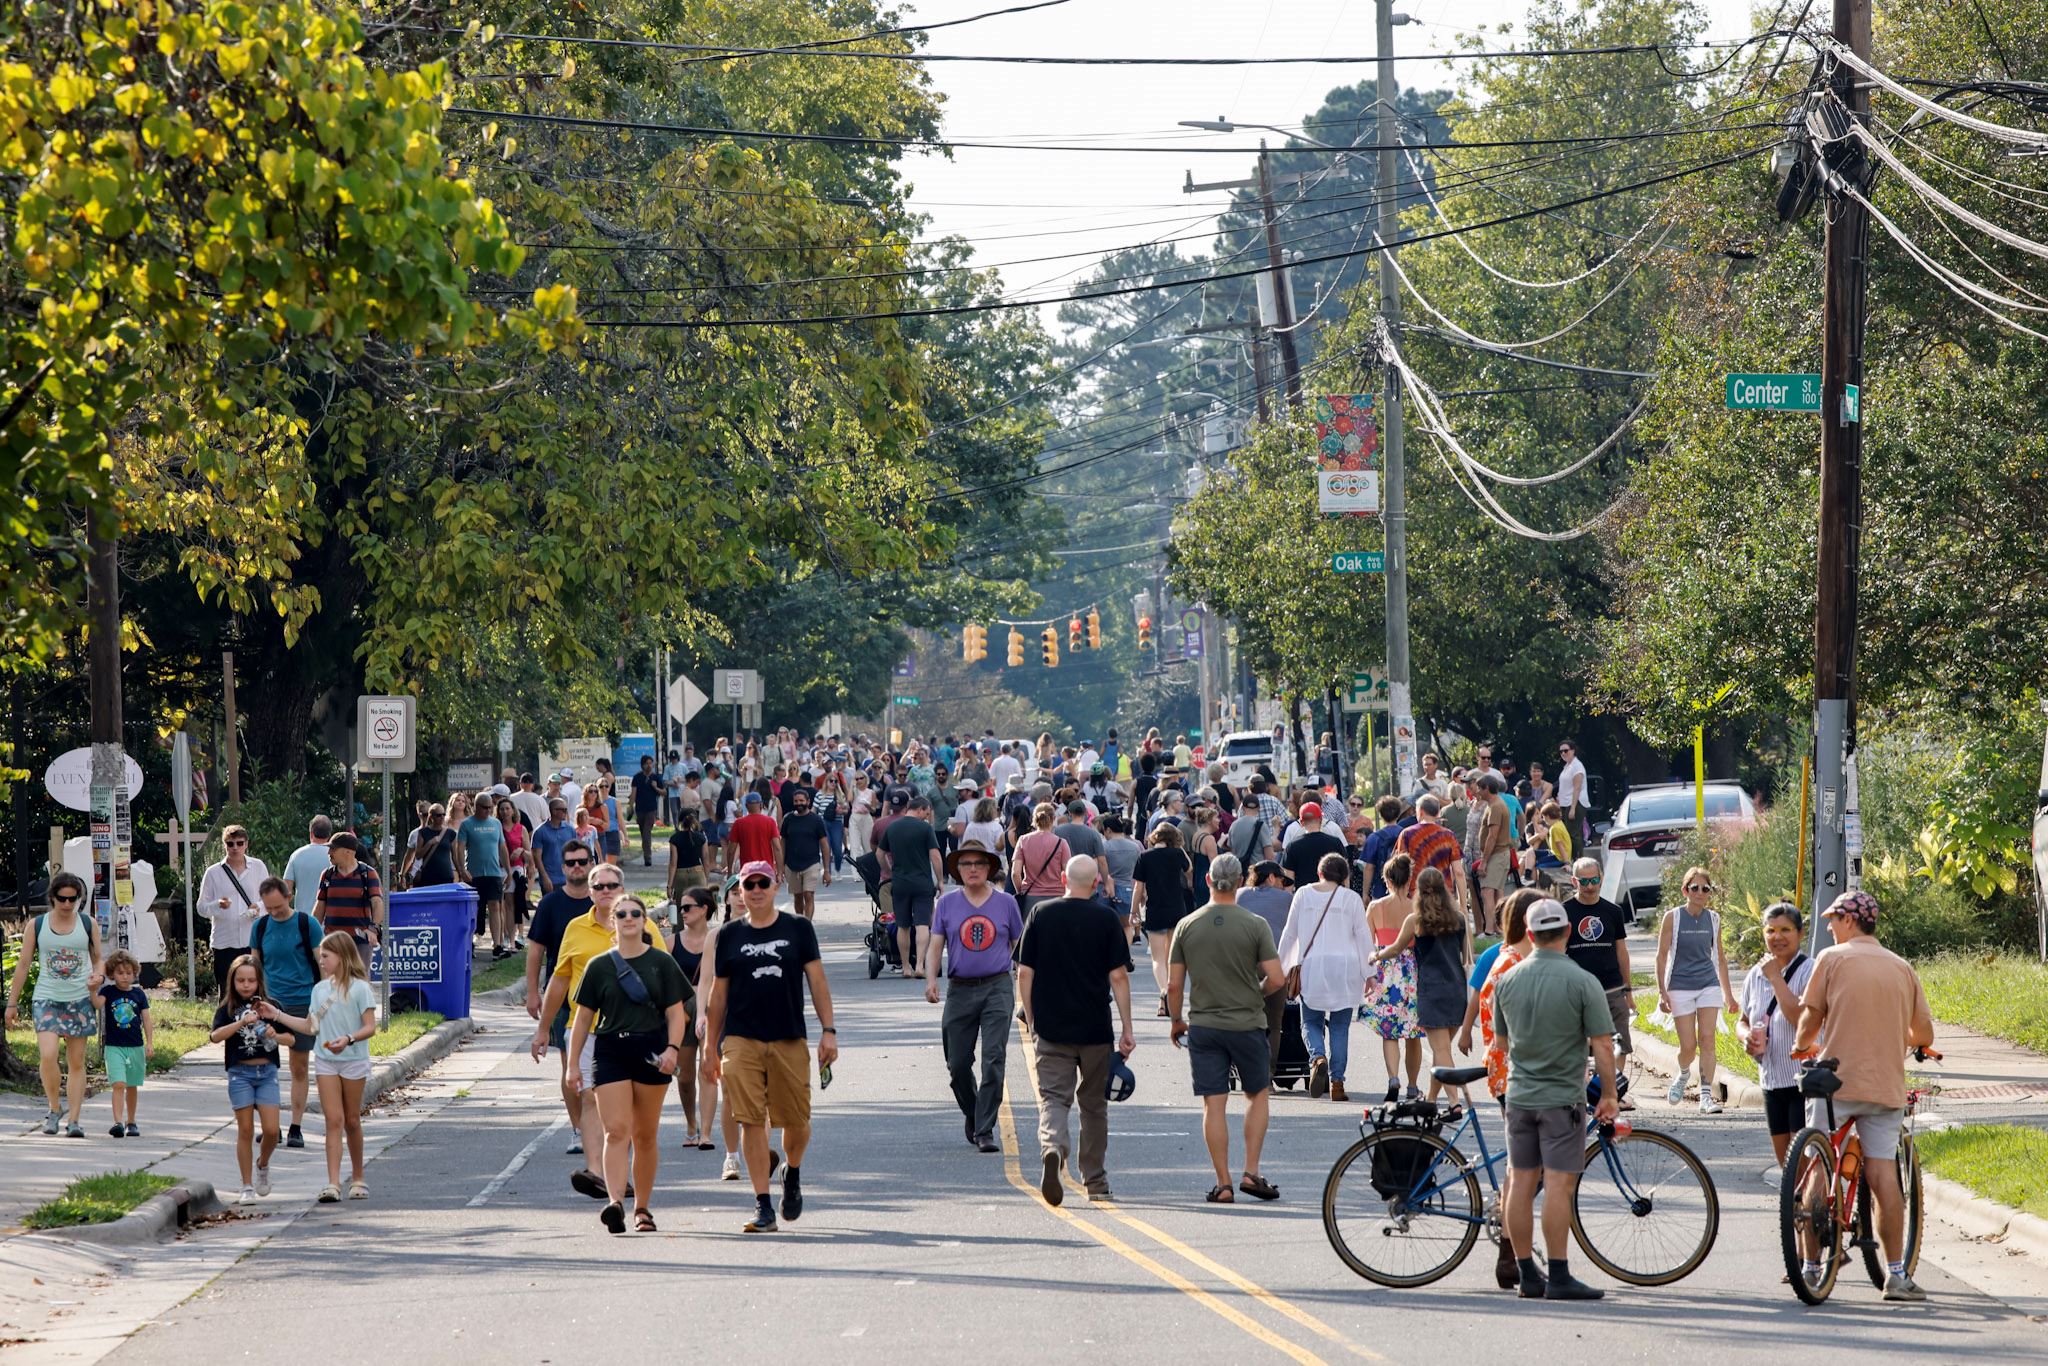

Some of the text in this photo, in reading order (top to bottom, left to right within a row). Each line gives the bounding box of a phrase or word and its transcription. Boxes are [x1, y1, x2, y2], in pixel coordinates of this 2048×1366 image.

[1734, 379, 1812, 404] Center St
[1802, 393, 1817, 404] 100
[1336, 556, 1363, 570] Oak
[569, 747, 591, 755] orange
[570, 752, 595, 760] literacy
